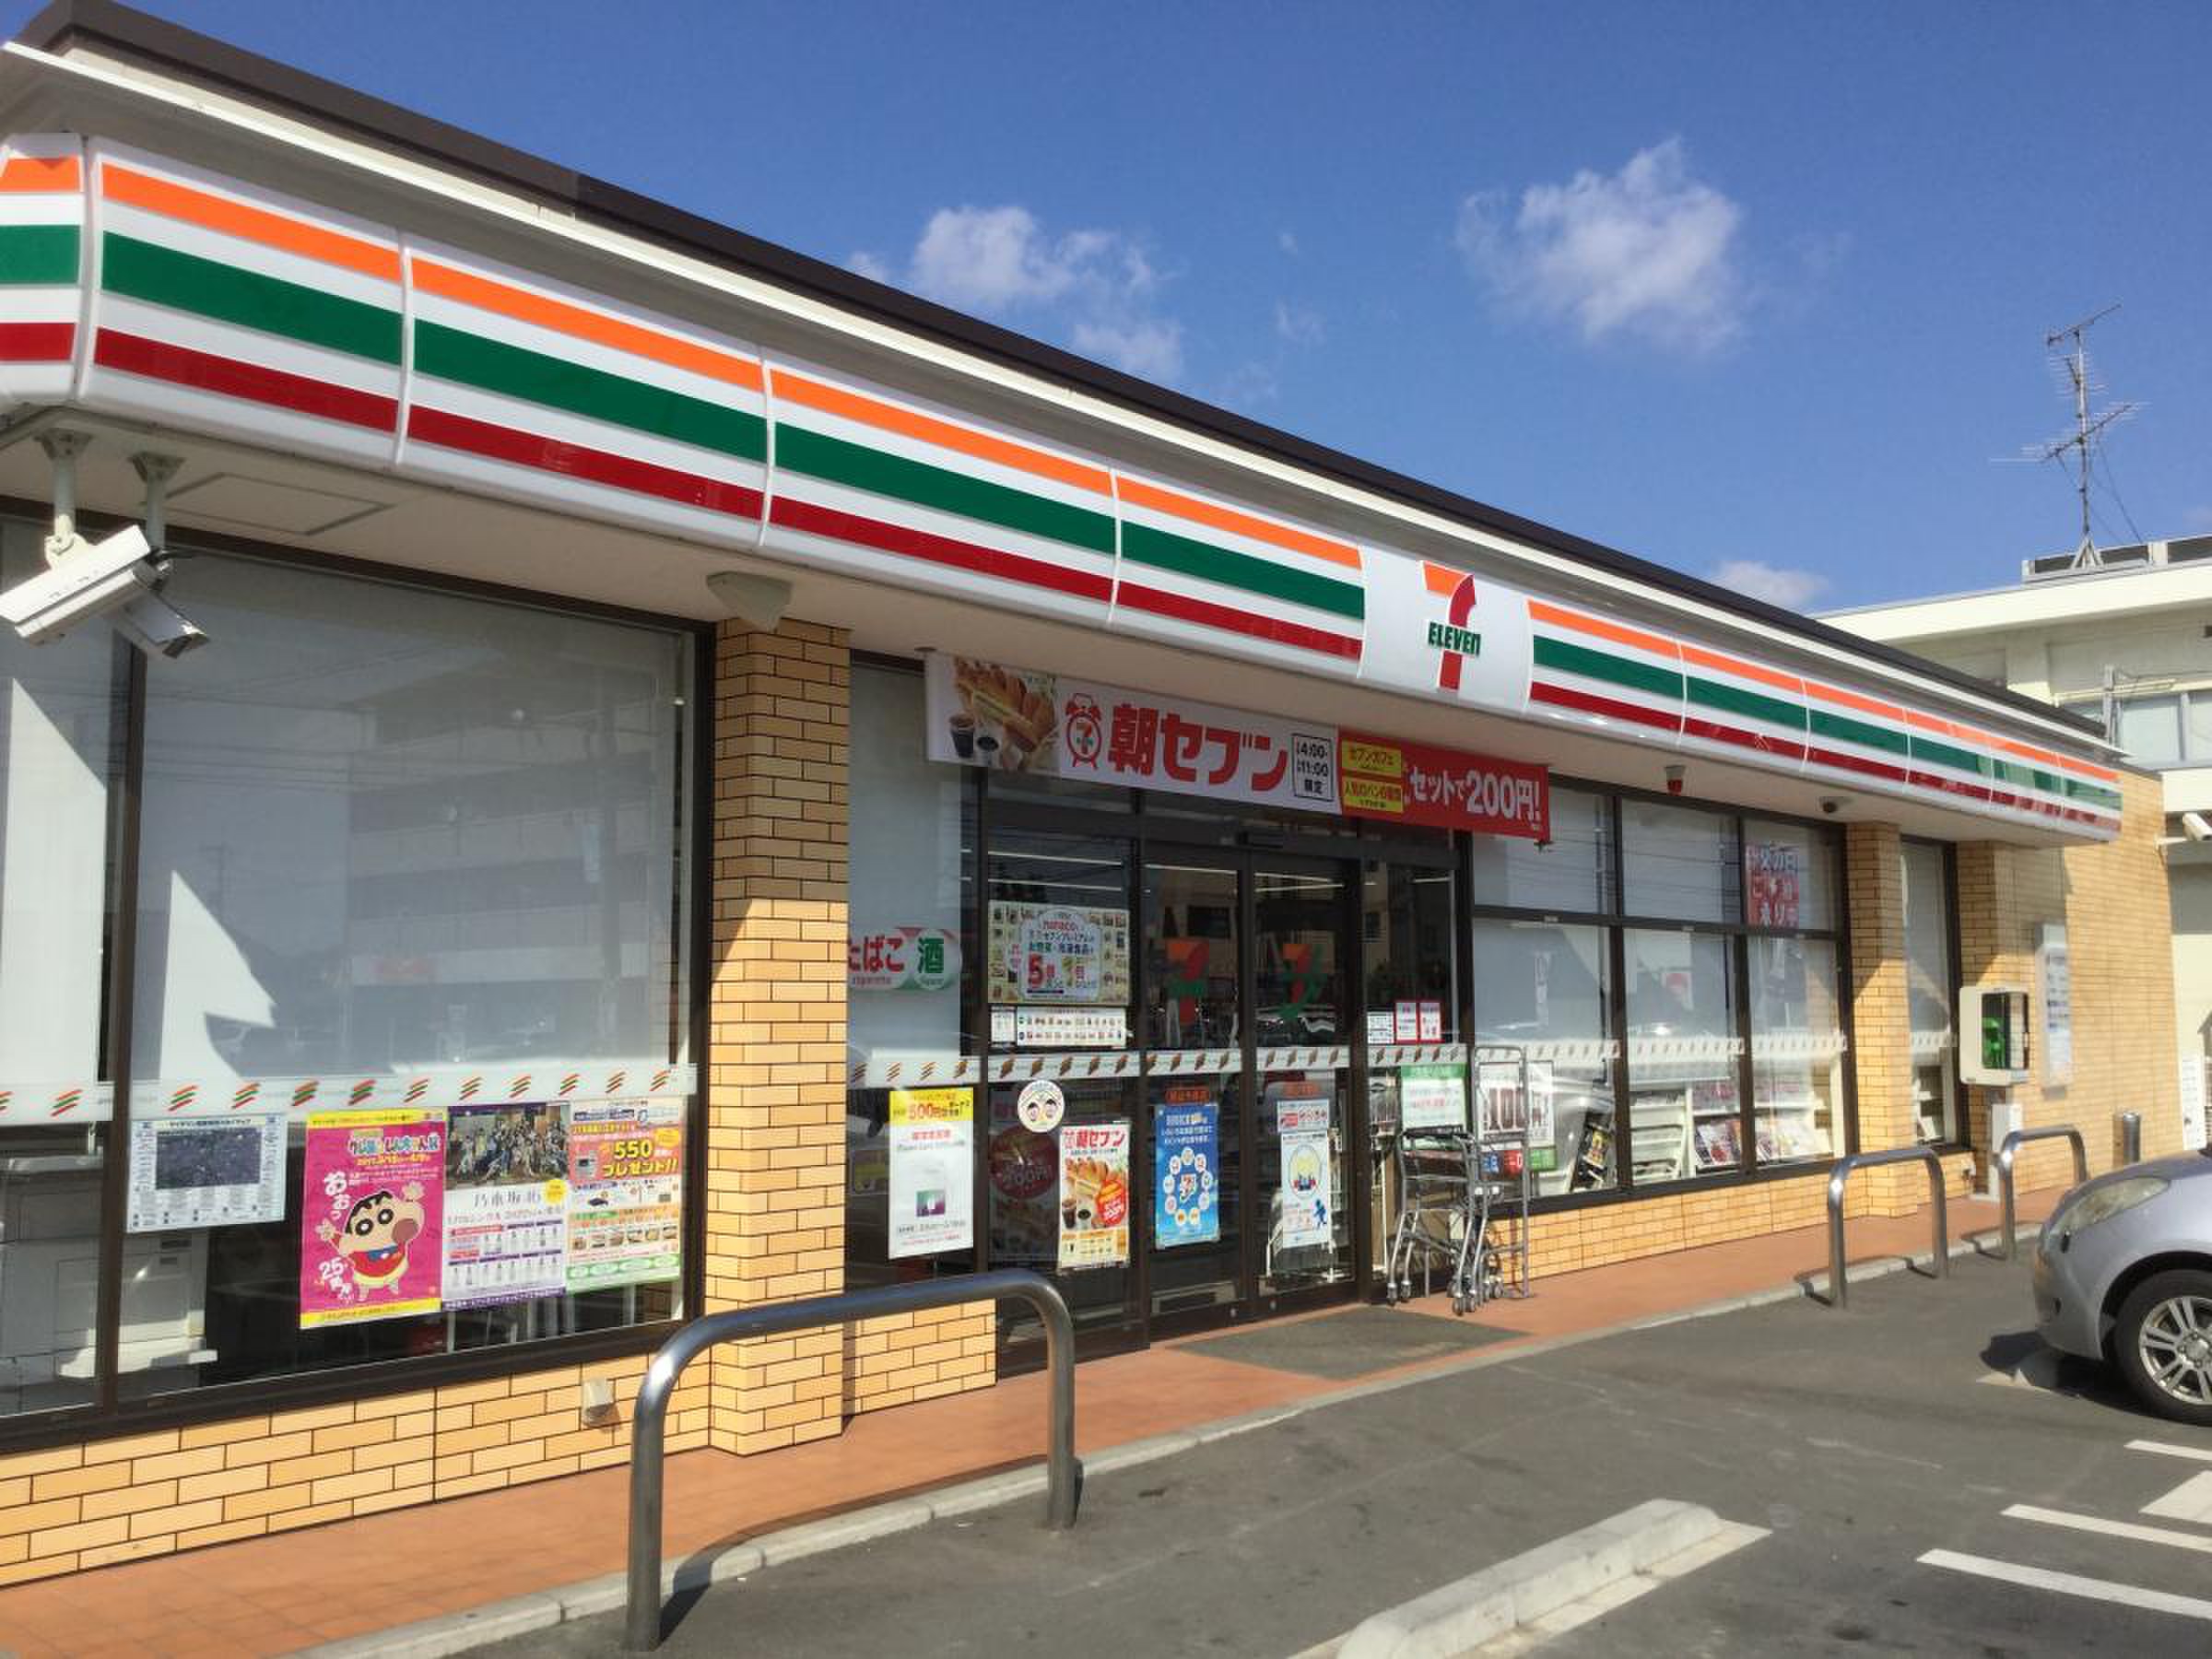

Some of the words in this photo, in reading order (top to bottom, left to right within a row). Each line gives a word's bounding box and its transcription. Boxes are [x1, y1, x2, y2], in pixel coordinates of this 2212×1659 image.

[1106, 703, 1288, 793] 朝セブン
[917, 936, 944, 973] 酒
